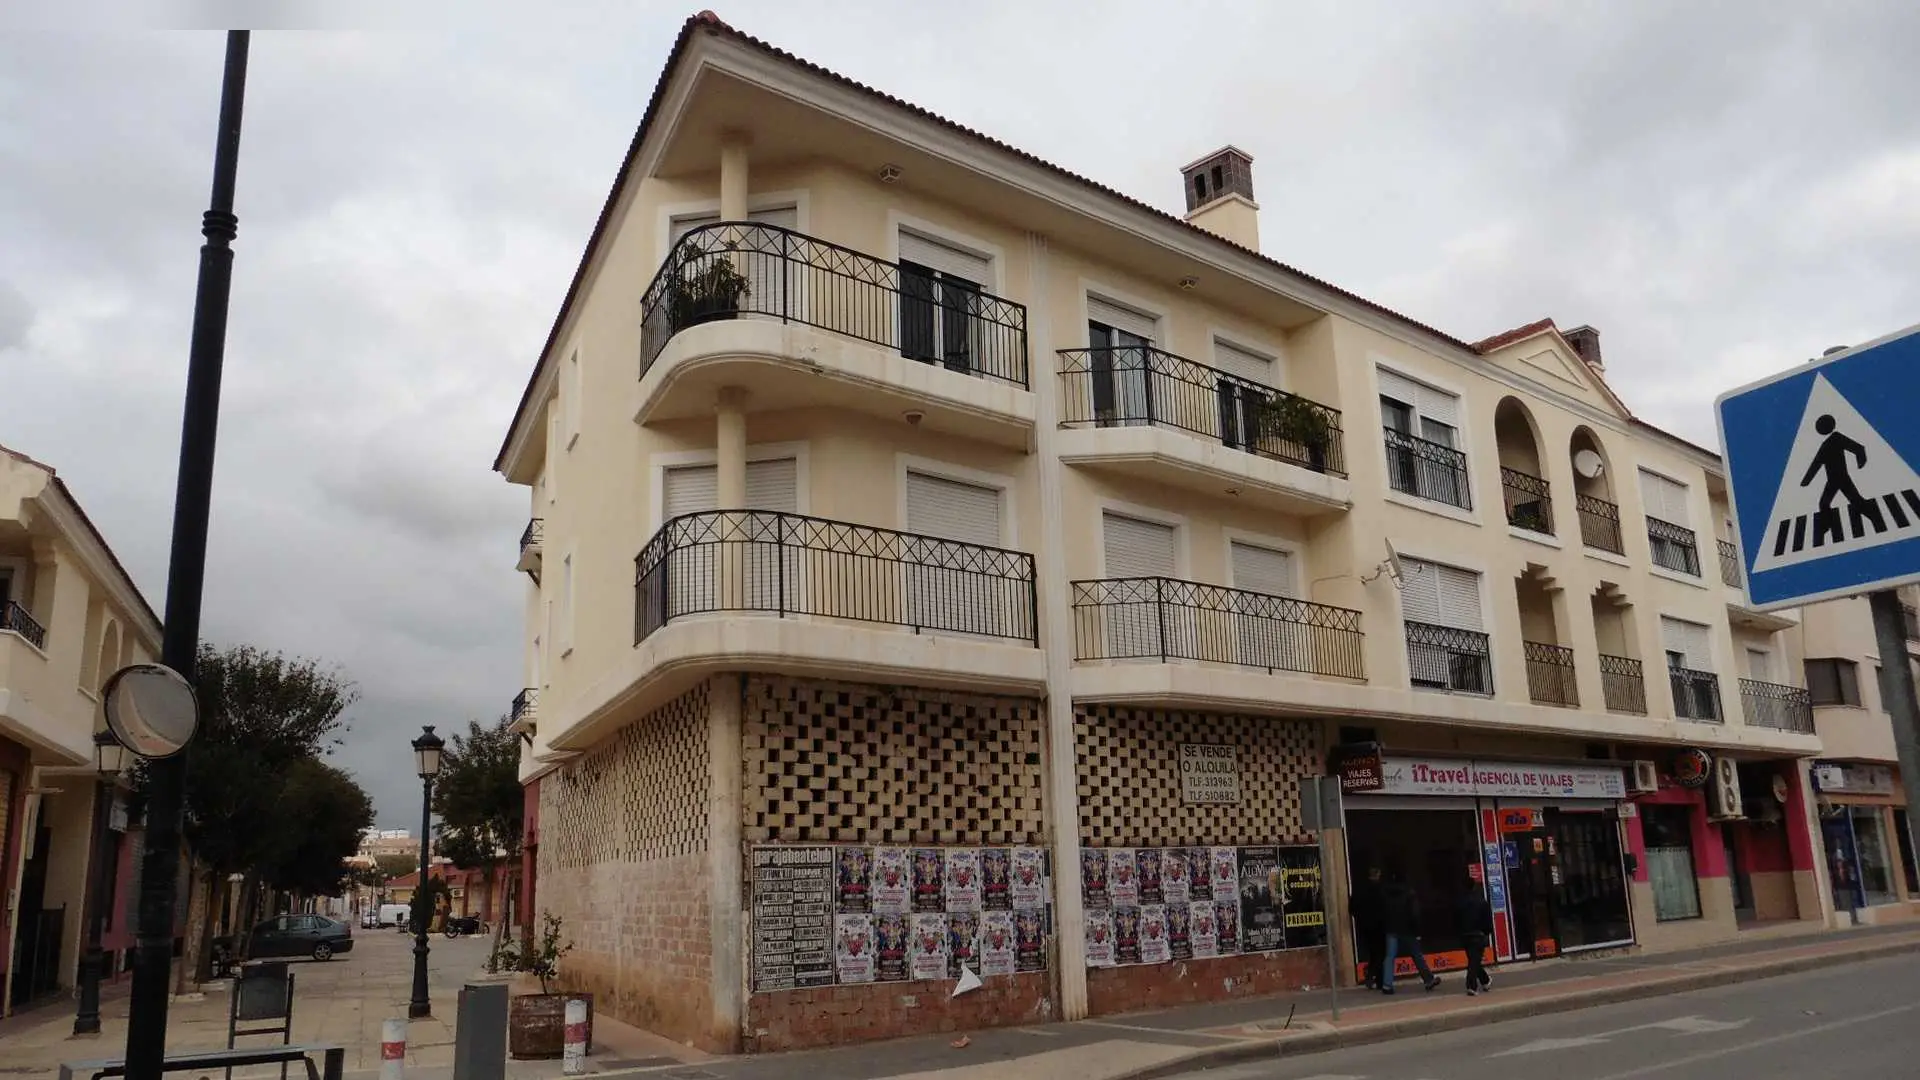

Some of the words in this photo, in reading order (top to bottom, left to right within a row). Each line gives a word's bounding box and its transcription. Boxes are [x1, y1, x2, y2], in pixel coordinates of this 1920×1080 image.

[1184, 745, 1198, 757] SE
[1199, 745, 1233, 758] VENDE
[1182, 760, 1191, 773] O
[1195, 760, 1236, 774] ALQUILA
[1347, 768, 1373, 779] VIAJES
[1411, 763, 1470, 785] iTravel
[1472, 771, 1521, 786] AGENCIA
[1523, 773, 1537, 786] DE
[1539, 773, 1574, 787] VIAJES
[1343, 777, 1379, 788] RESERVAS
